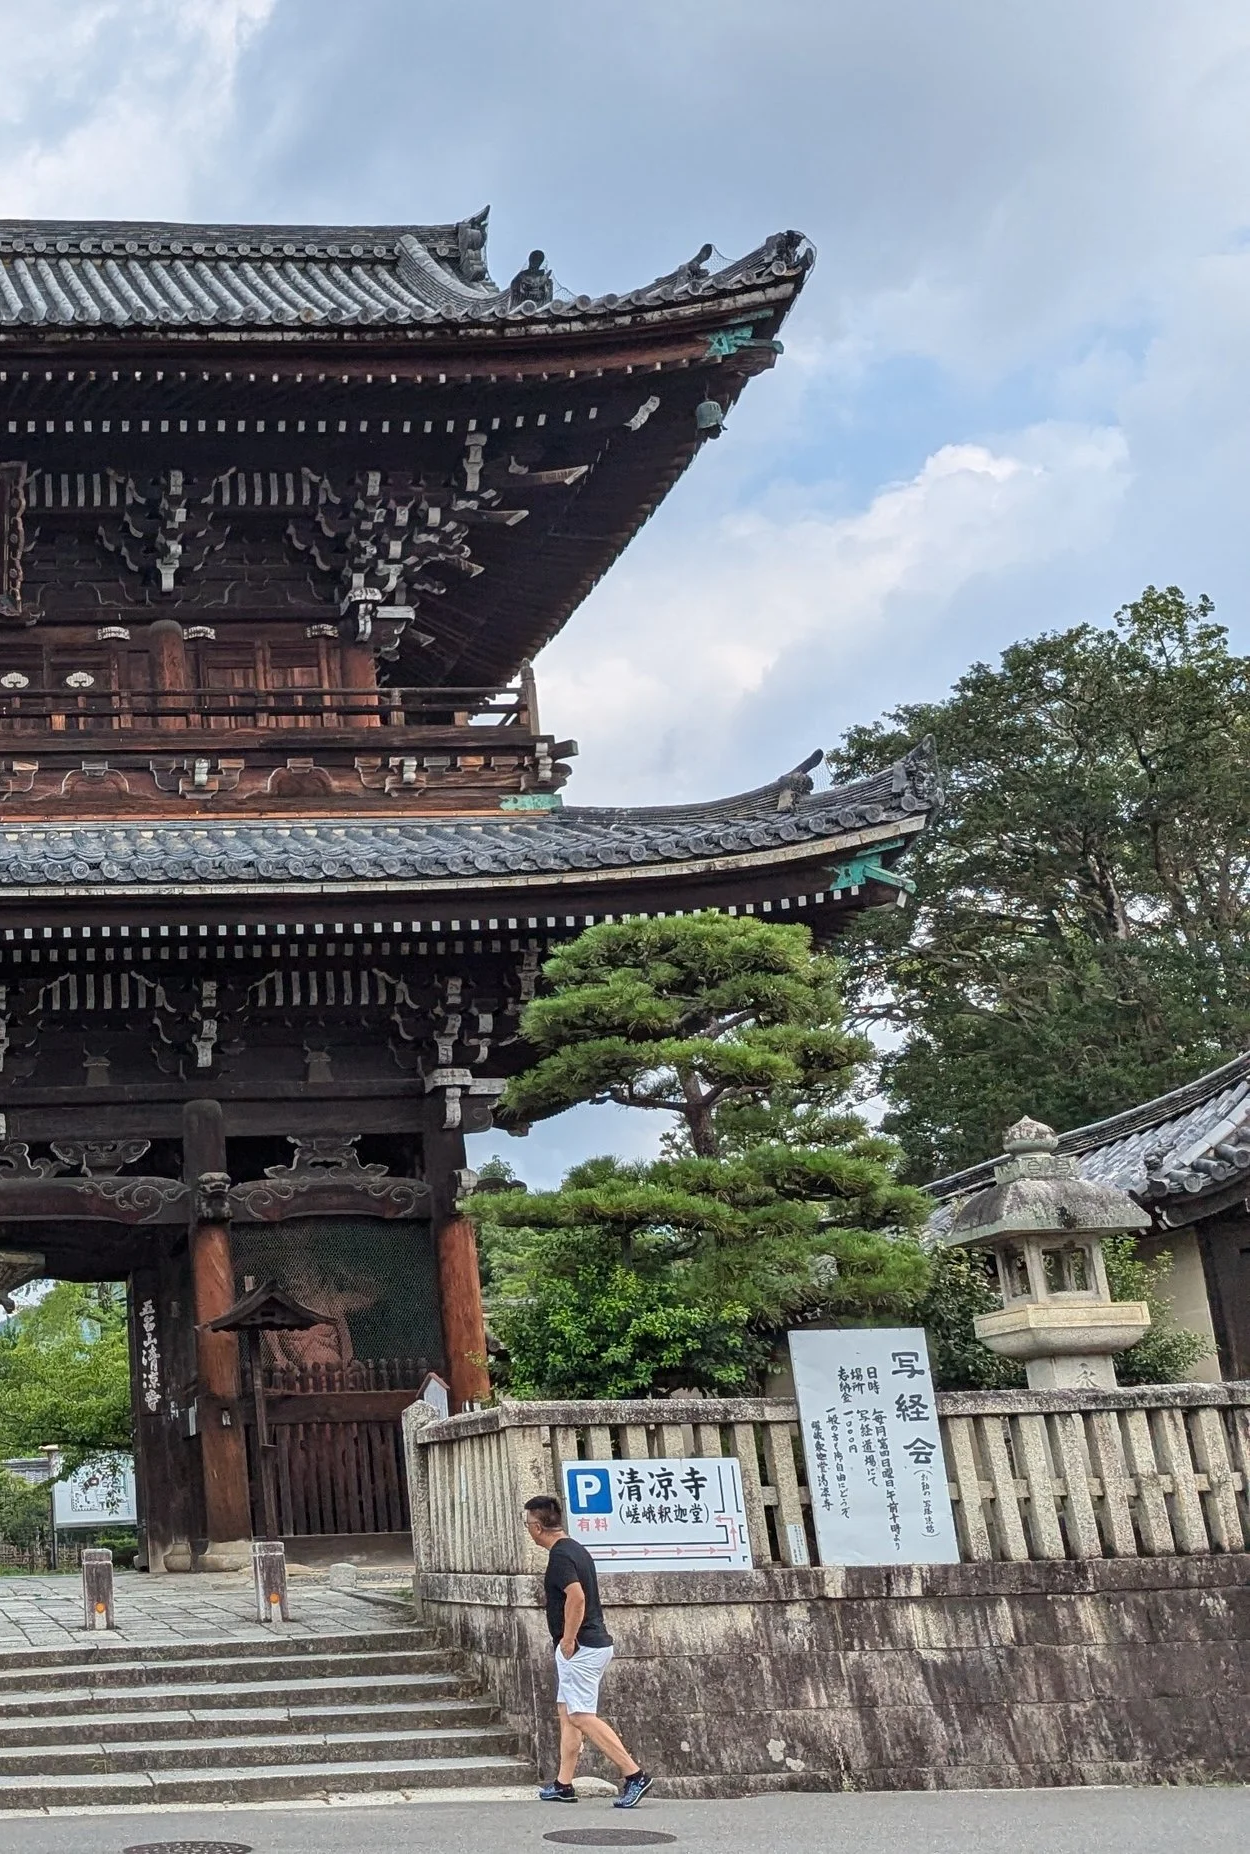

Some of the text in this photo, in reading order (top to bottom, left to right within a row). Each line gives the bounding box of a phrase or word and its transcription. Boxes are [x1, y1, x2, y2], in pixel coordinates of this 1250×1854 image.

[837, 1366, 853, 1404] 志納金
[867, 1366, 880, 1395] 日時
[891, 1351, 936, 1466] 写経会
[850, 1367, 878, 1487] 場所 写経道場にて
[575, 1474, 601, 1508] P
[577, 1517, 608, 1532] 有料
[618, 1503, 710, 1525] （嵯峨釈迦堂）
